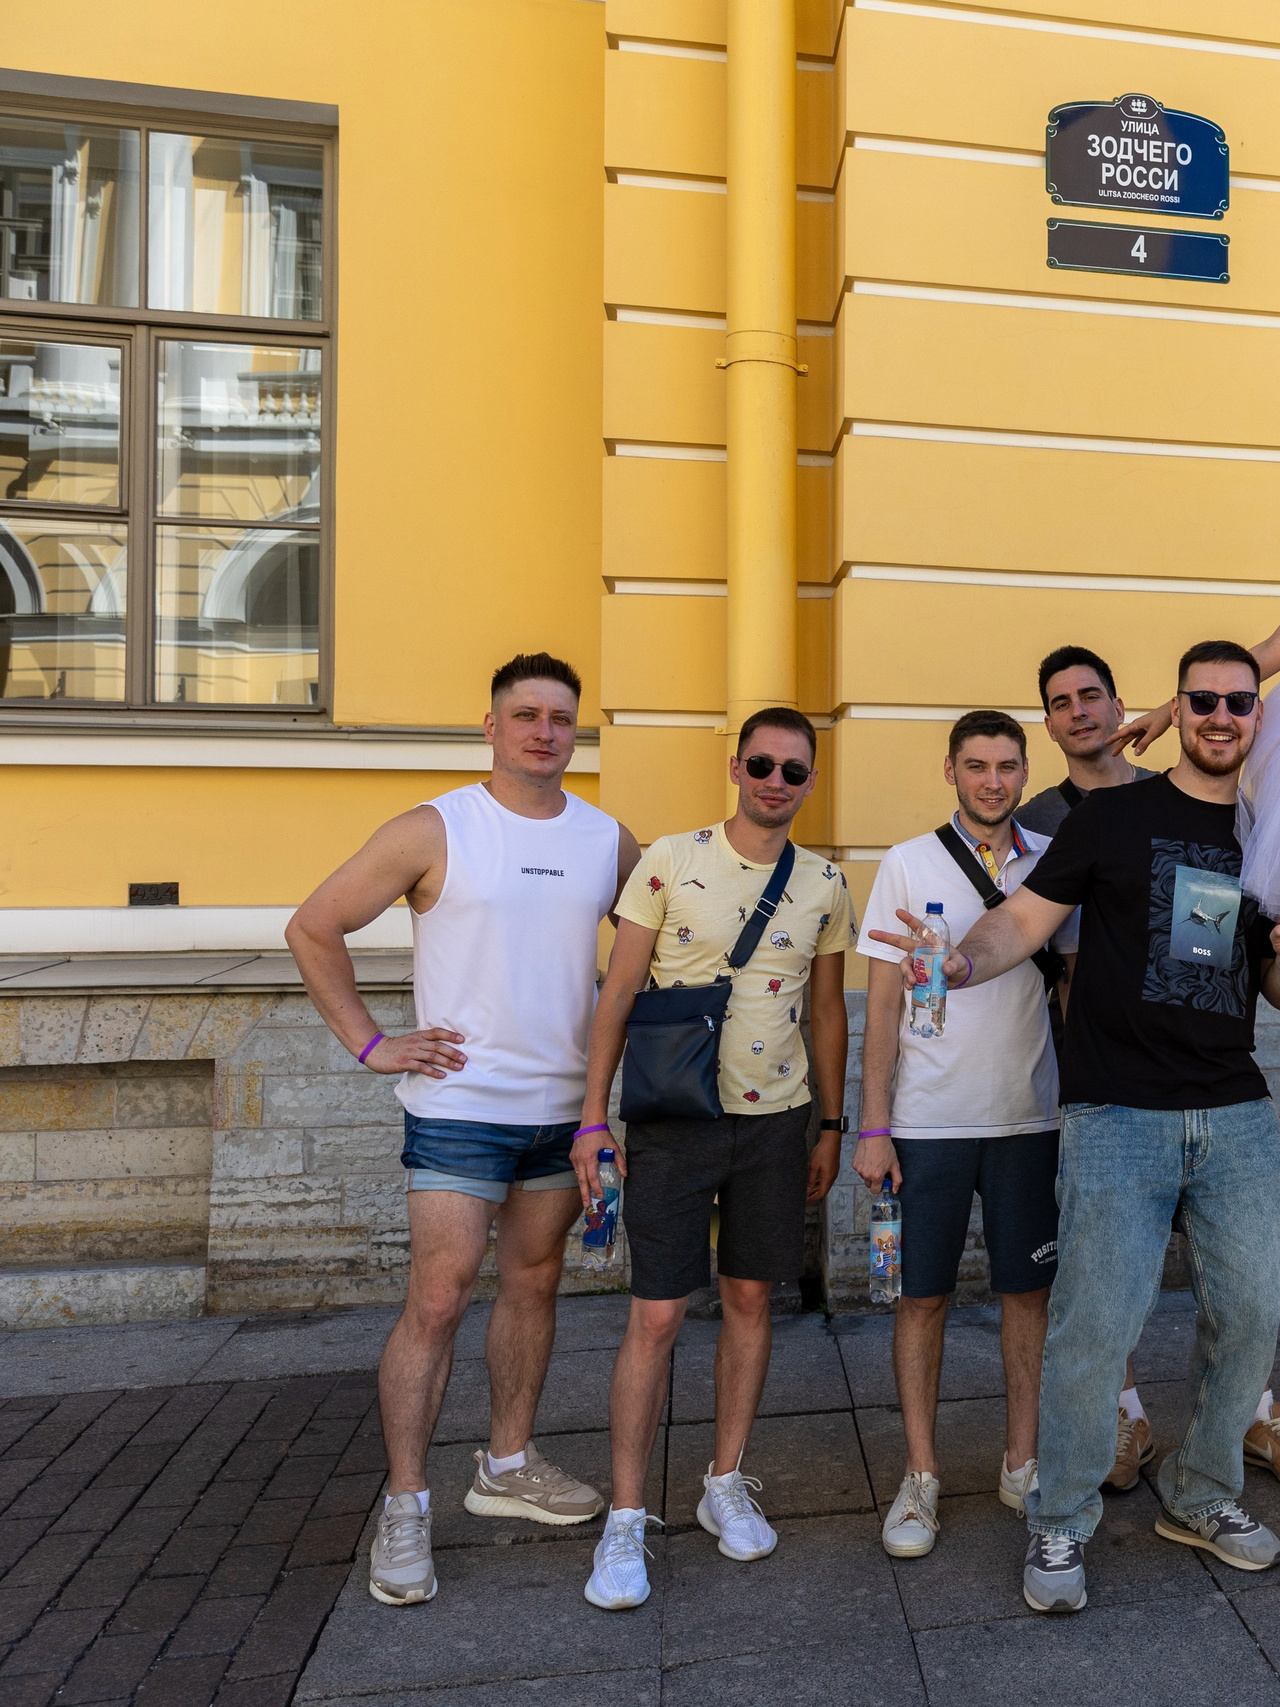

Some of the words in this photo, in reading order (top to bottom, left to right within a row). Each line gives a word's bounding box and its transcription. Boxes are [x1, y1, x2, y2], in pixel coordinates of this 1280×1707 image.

[1121, 120, 1159, 136] УЛИЦА
[1087, 134, 1192, 165] ЗОДЧЕГО
[1101, 163, 1178, 191] РОССИ
[1098, 189, 1122, 198] ULITSA
[1122, 191, 1160, 202] ZODCHEGO
[1160, 195, 1180, 203] ROSSI
[1131, 235, 1147, 263] 4
[521, 867, 565, 877] UNSTOPPABLE
[1192, 946, 1211, 957] BOSS
